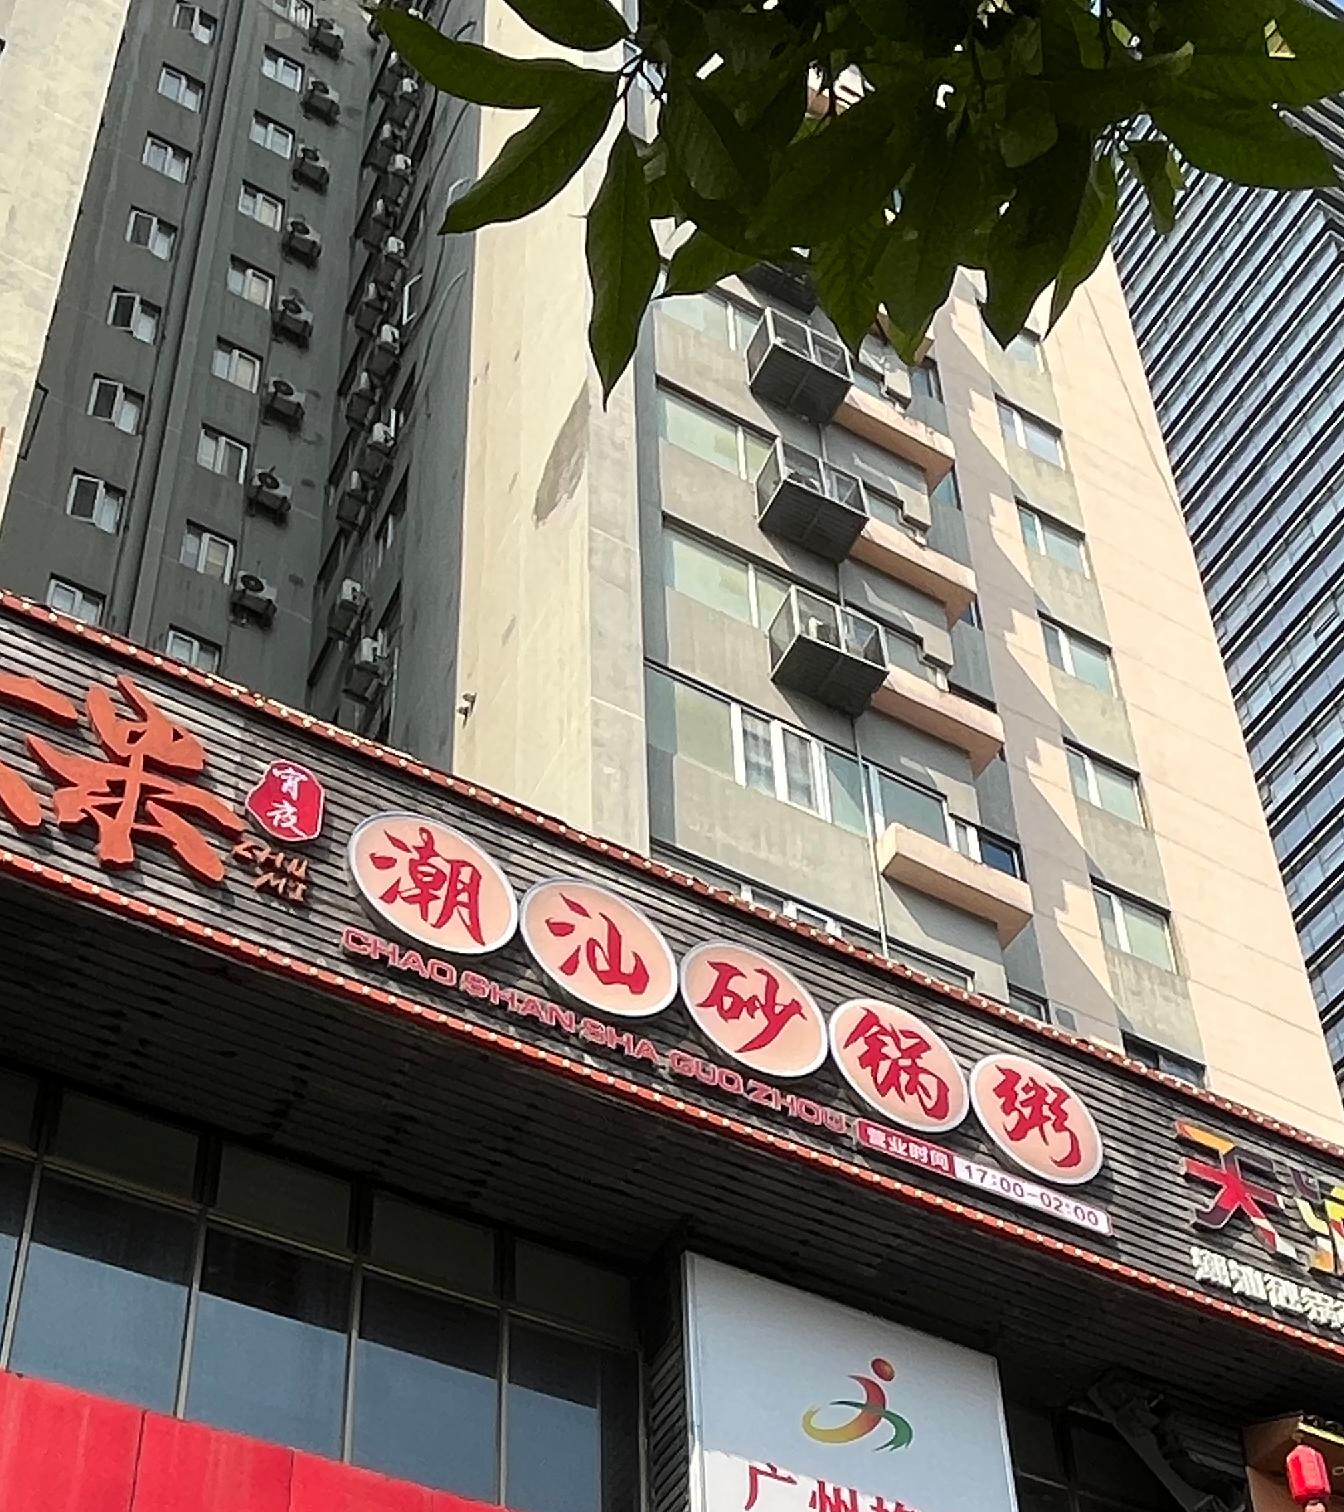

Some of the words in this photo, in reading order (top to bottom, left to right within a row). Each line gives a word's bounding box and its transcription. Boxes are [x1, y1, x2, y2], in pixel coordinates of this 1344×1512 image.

[342, 925, 456, 987] CHAO
[369, 827, 1084, 1170] 潮汕砂锅粥
[865, 1125, 950, 1173] 营业时间
